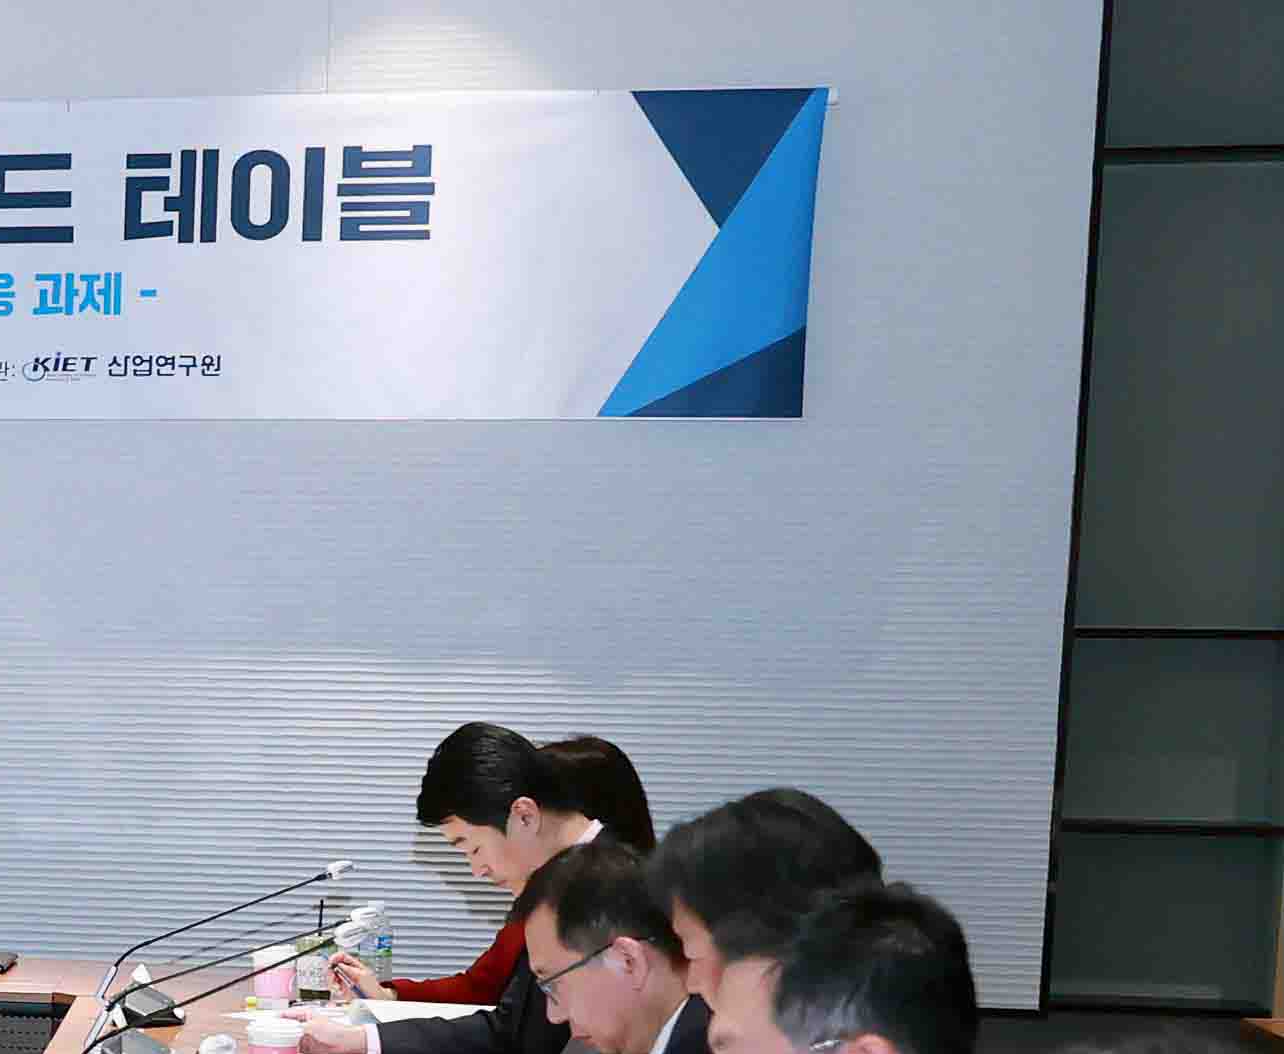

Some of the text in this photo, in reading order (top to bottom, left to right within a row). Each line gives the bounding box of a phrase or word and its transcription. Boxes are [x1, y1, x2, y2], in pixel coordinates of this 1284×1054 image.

[120, 144, 435, 244] 테이블
[32, 272, 122, 315] 과제
[108, 352, 221, 377] 산업연구원
